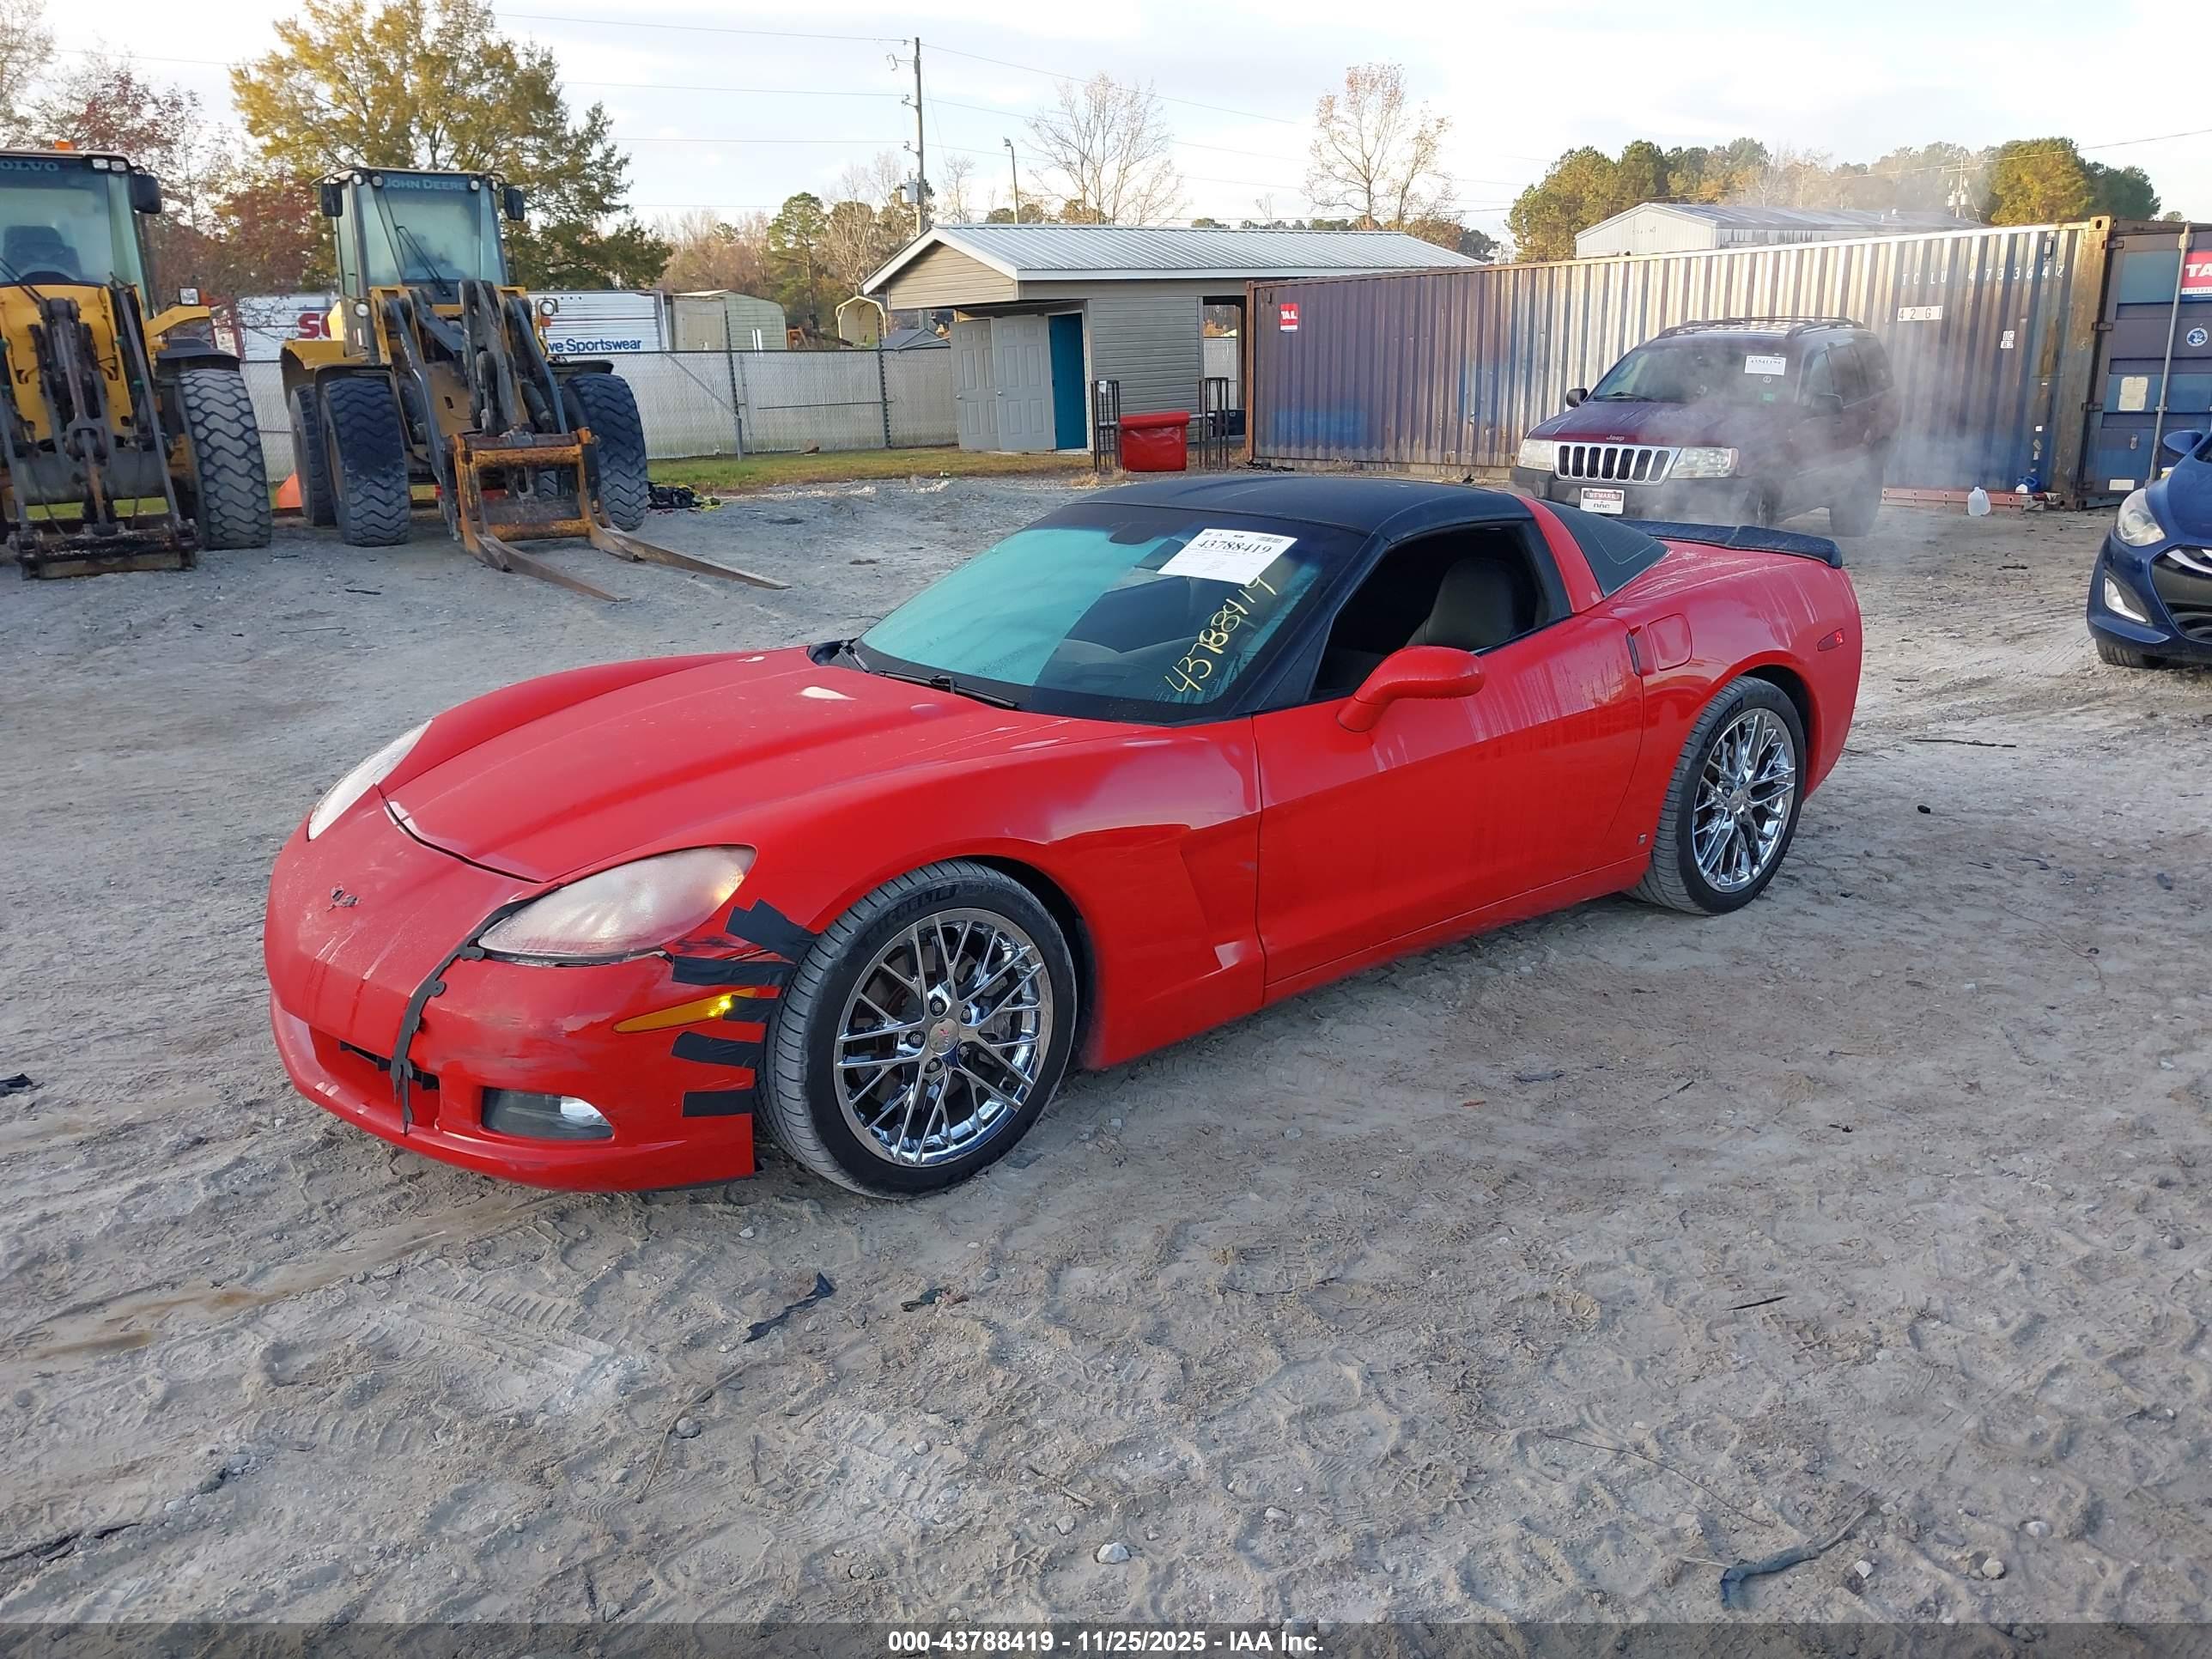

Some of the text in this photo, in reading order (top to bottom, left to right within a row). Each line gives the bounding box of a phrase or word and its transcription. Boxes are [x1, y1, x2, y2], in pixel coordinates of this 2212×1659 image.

[0, 160, 59, 172] OLVO
[384, 178, 467, 191] JOHN DEERE
[2185, 263, 2212, 278] TA
[566, 337, 642, 354] Sportswear
[1197, 539, 1273, 555] 43788419
[1164, 576, 1278, 692] 43788419
